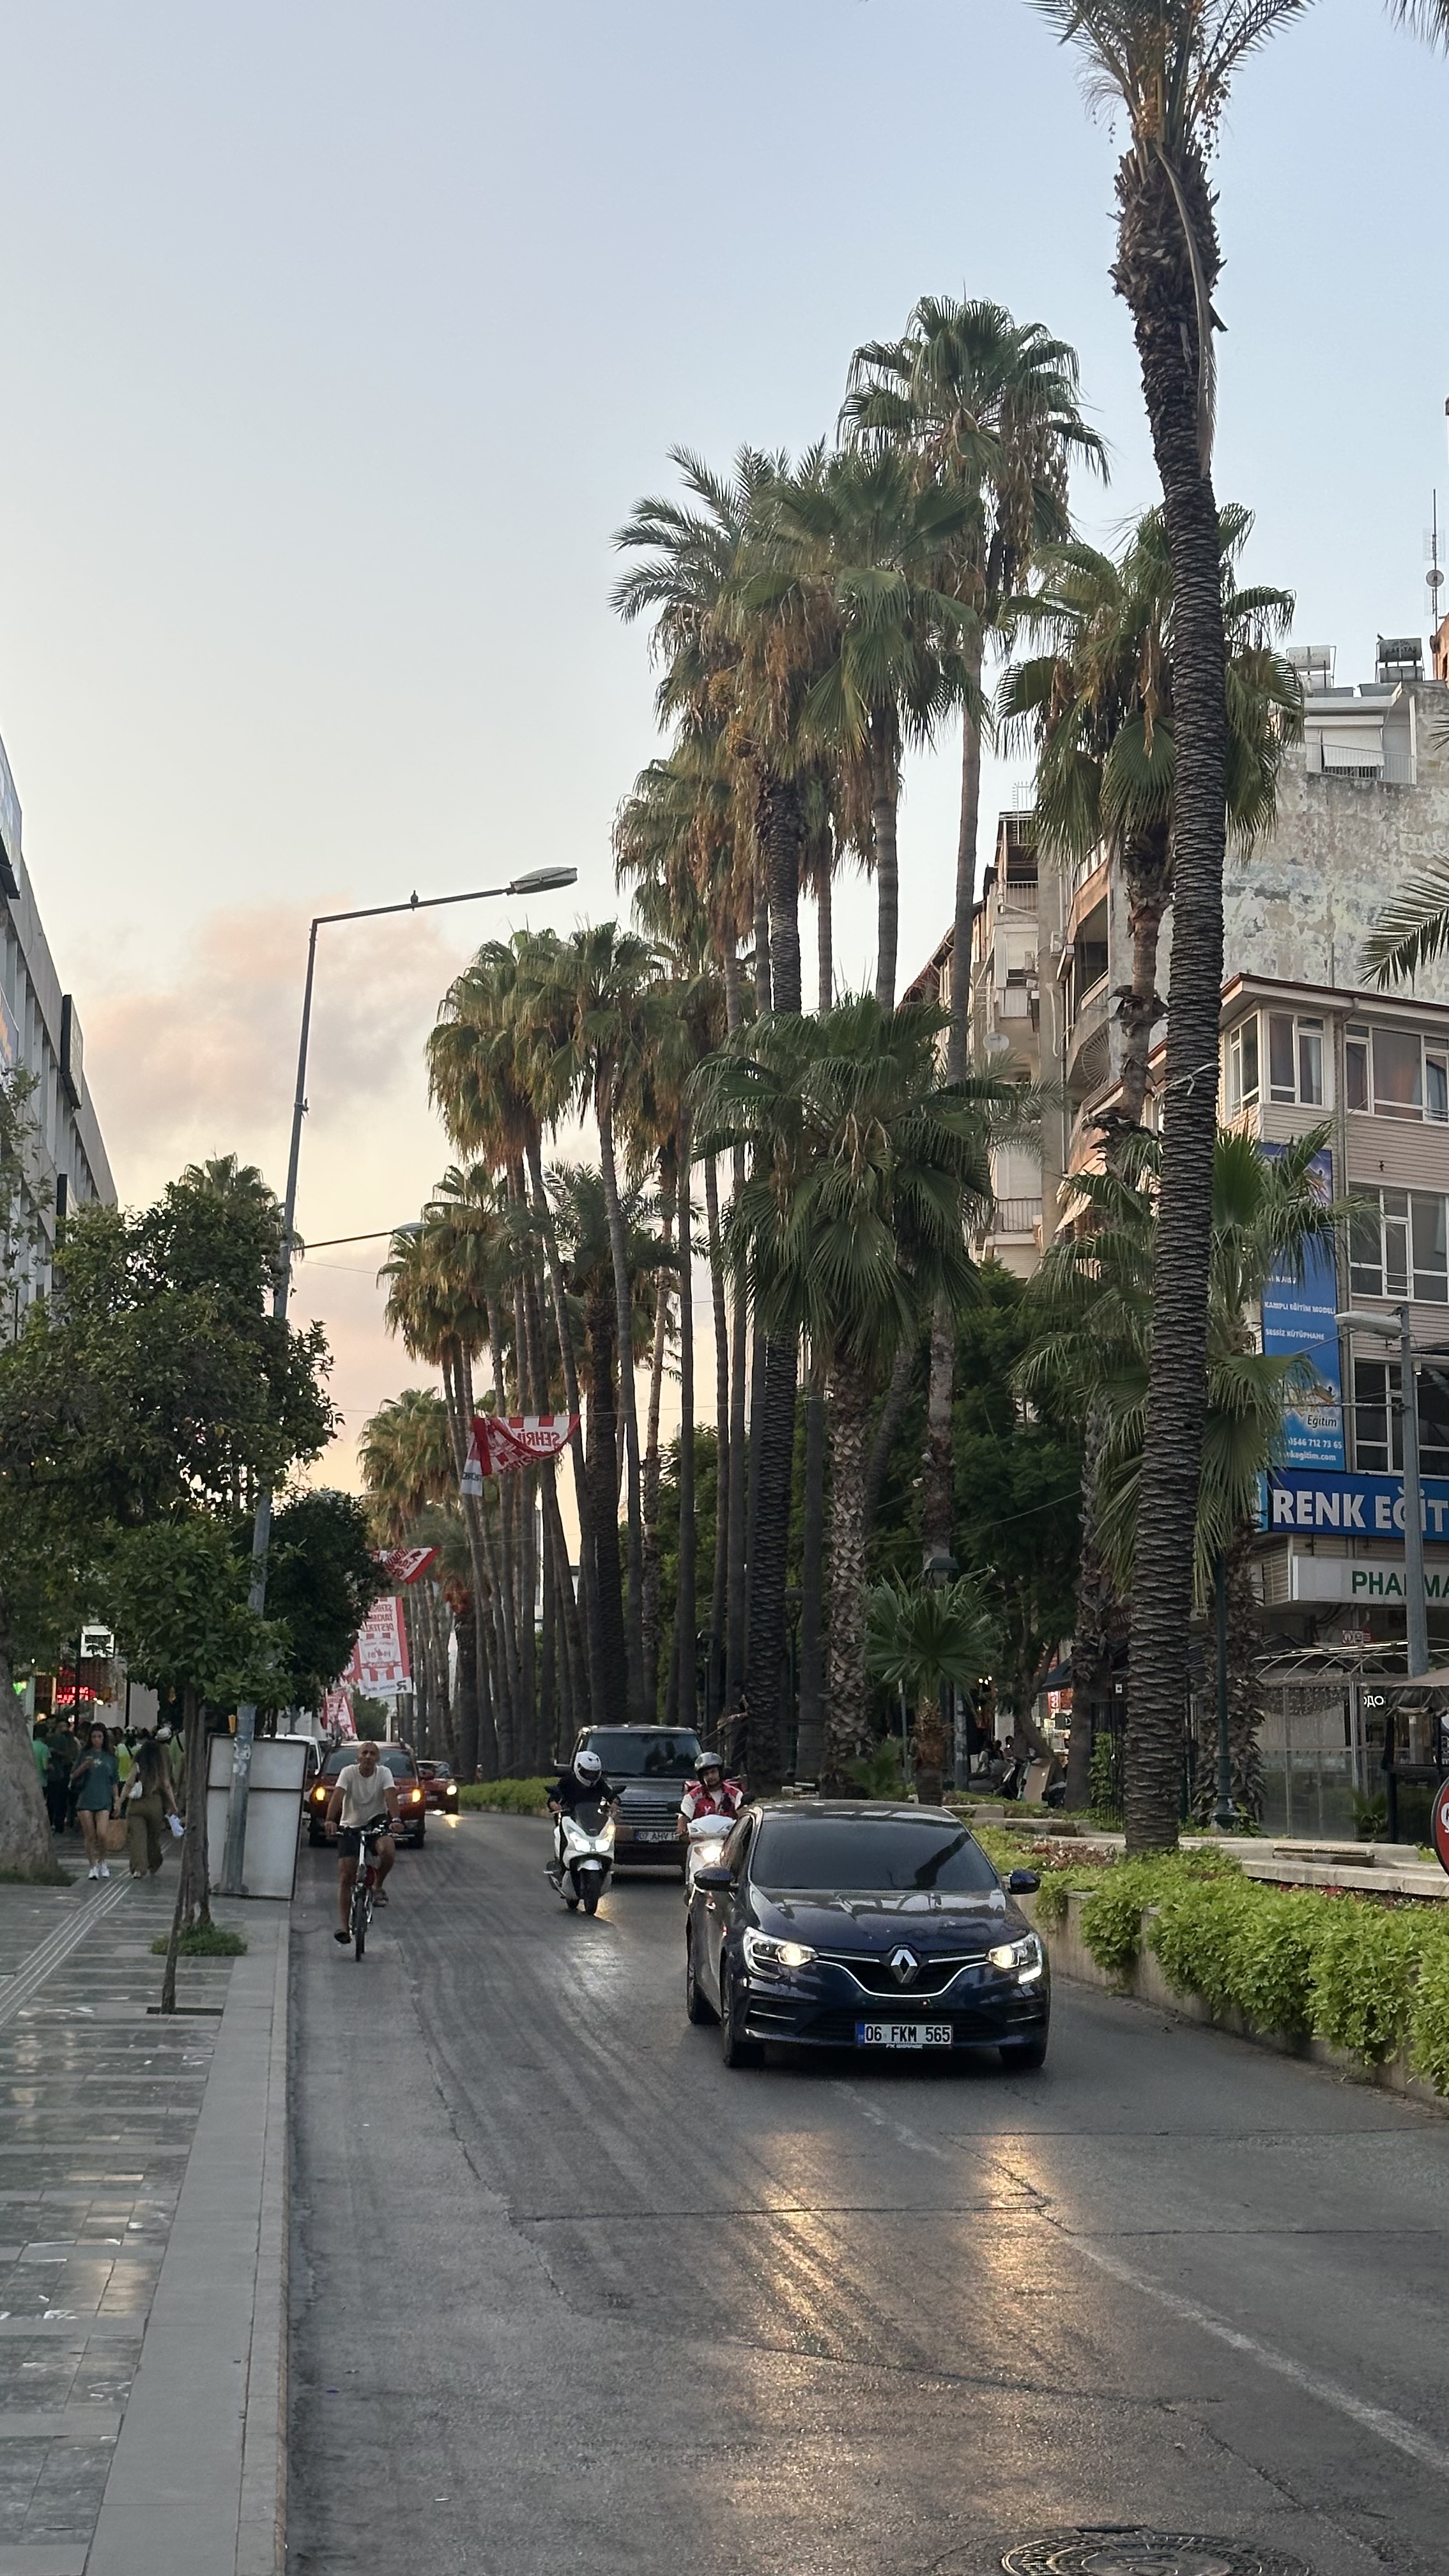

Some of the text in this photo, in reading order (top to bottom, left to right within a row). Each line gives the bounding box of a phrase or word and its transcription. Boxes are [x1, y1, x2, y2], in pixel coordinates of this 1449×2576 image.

[1264, 1301, 1289, 1310] KAMPLI
[1266, 1328, 1324, 1340] SESSİZ KÜTÜPHANE
[1307, 1414, 1337, 1428] Eğitim
[1308, 1439, 1321, 1448] 712
[1322, 1440, 1331, 1448] 73
[1273, 1489, 1366, 1528] RENK
[1351, 1570, 1449, 1598] PHAM
[866, 2025, 951, 2043] 06 FKM 565
